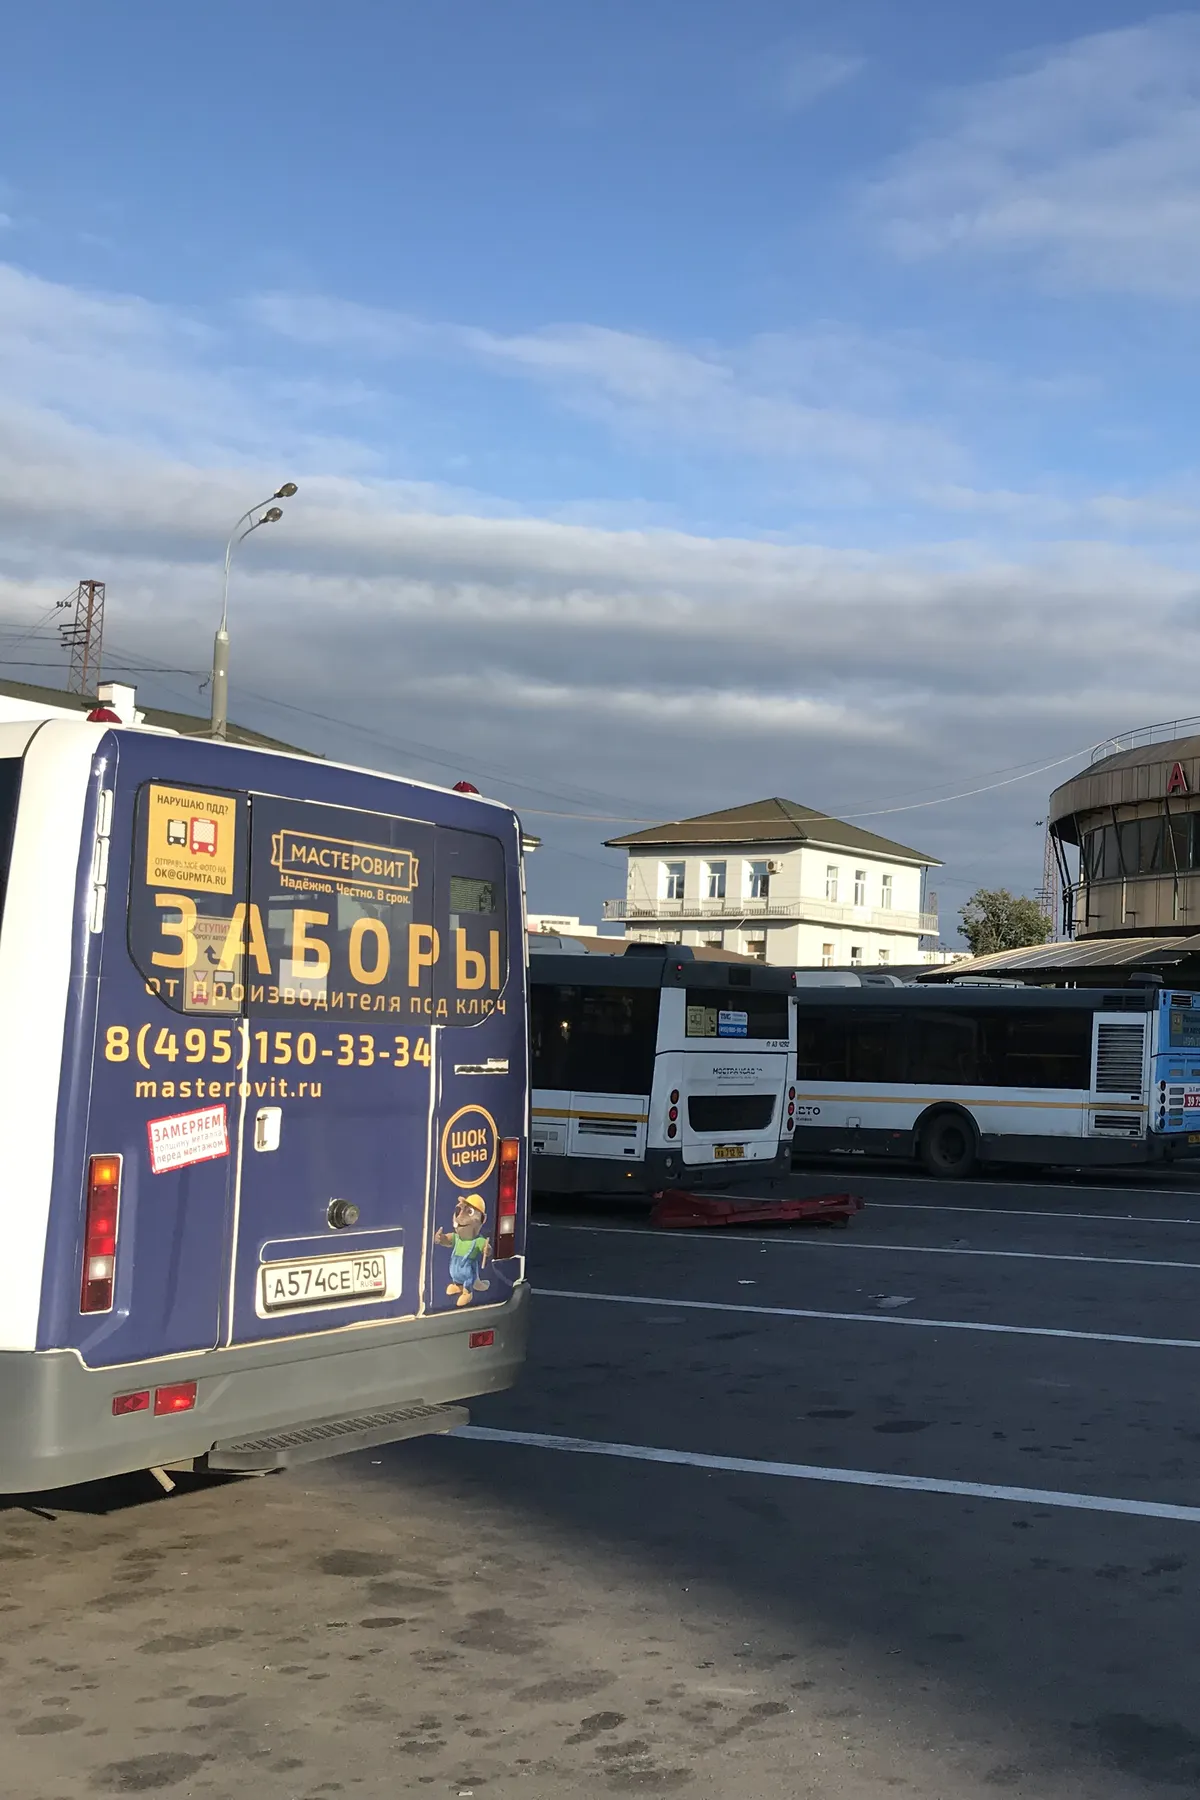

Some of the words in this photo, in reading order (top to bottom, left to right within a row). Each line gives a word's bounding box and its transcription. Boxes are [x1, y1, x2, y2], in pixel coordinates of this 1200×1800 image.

[157, 794, 205, 811] НАРУШАЮ
[206, 802, 229, 816] ПДД?
[291, 843, 405, 879] МАСТЕРОВИТ
[154, 867, 227, 886] OK@GUPMTA.RU
[280, 874, 334, 894] Надёжно.
[336, 882, 376, 900] Честно.
[377, 889, 385, 900] В
[386, 893, 411, 905] срок.
[151, 893, 503, 991] ЗАБОРЫ
[145, 977, 180, 1000] от
[189, 979, 401, 1015] производителя
[410, 997, 448, 1018] под
[456, 999, 506, 1015] ключ
[104, 1023, 432, 1070] 8(495)150-33-34
[135, 1076, 322, 1099] masterovit.ru
[1187, 1096, 1195, 1106] 39
[154, 1114, 221, 1143] ЗАМЕРЯЕМ
[451, 1128, 487, 1149] ШОК
[452, 1148, 488, 1167] цена
[354, 1260, 380, 1280] 750
[274, 1267, 351, 1299] А574СЕ
[360, 1280, 374, 1288] RUS
